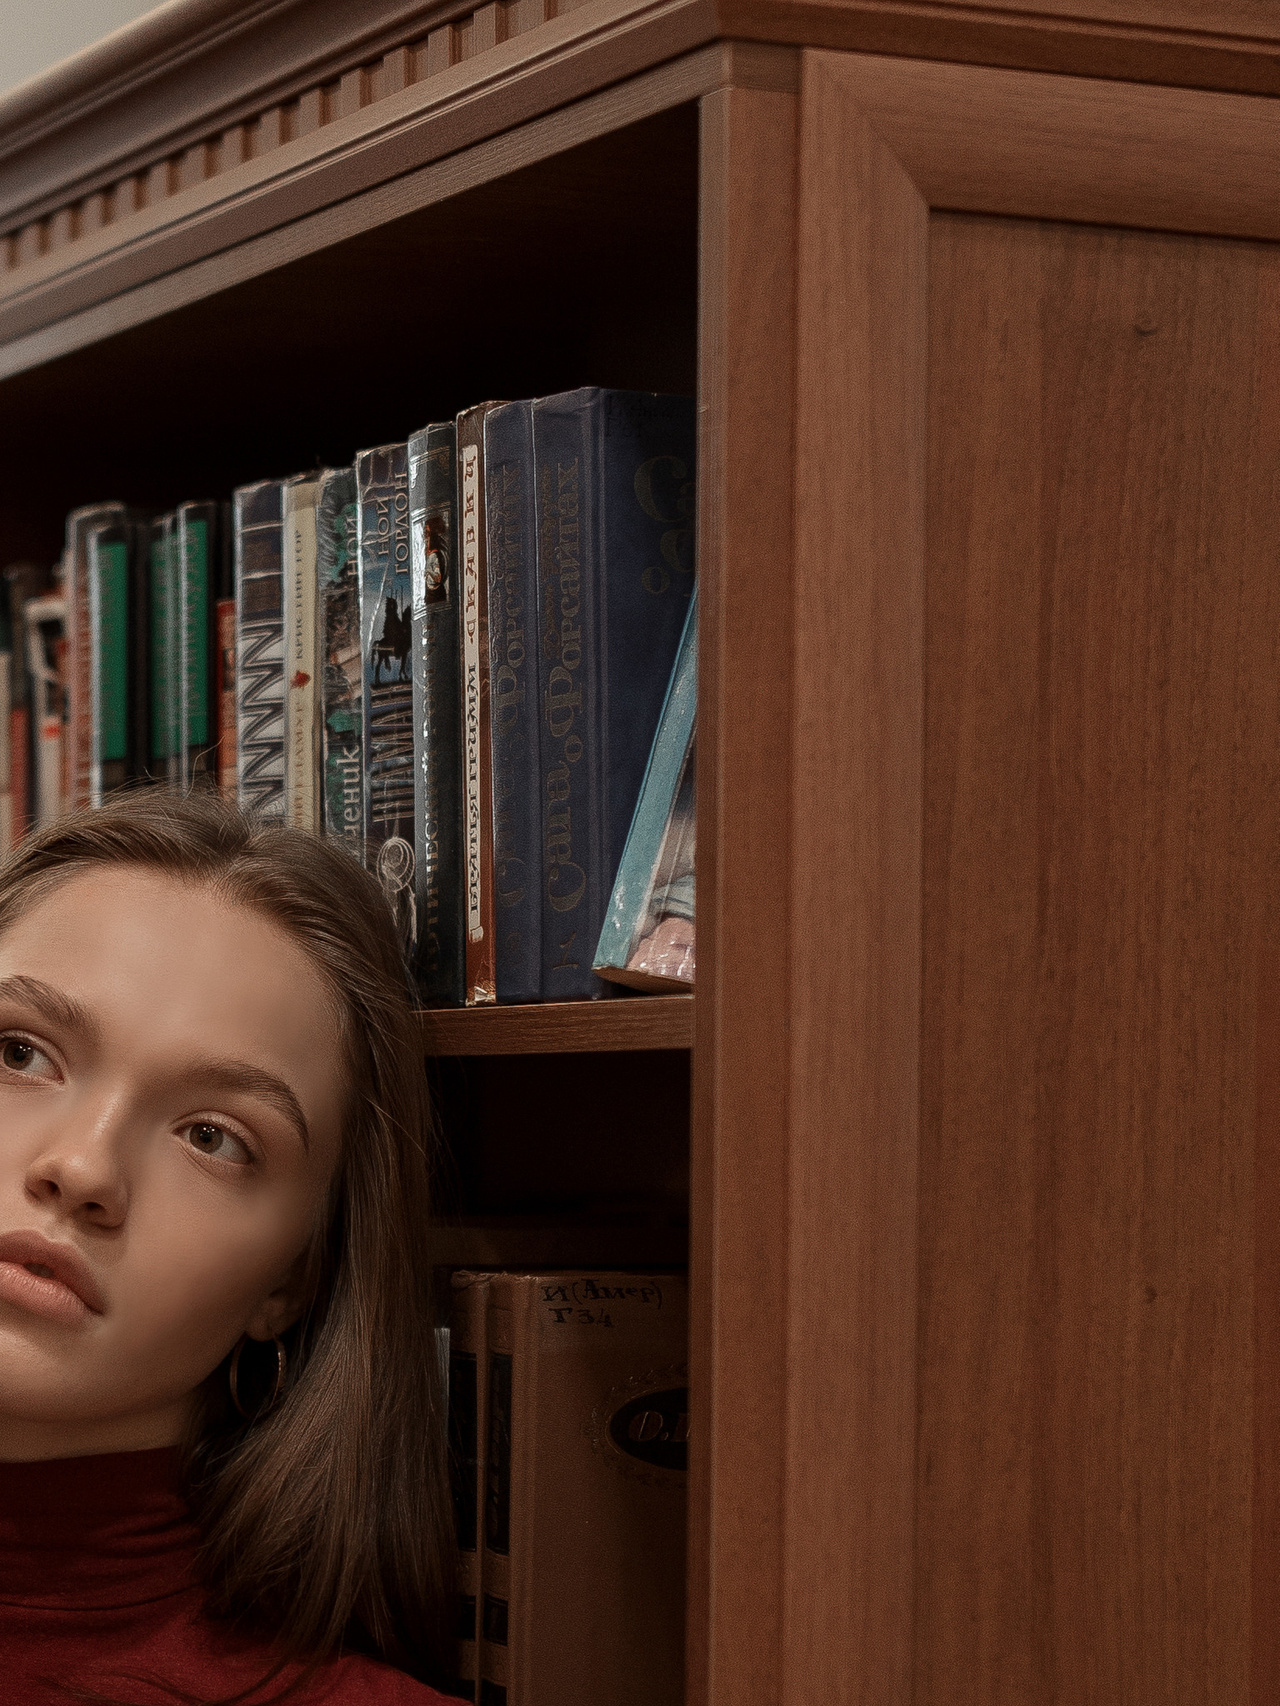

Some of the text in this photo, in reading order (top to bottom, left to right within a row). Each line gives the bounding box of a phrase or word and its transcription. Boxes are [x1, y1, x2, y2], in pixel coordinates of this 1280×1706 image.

[294, 529, 304, 563] ГОР
[343, 514, 359, 577] НОЙ
[374, 495, 390, 556] НОЙ
[393, 471, 410, 575] ГОРДОН
[640, 565, 671, 595] о
[542, 455, 586, 913] Сага о Форсайтах
[335, 745, 361, 848] ченик
[369, 680, 415, 823] ШАМАН
[467, 662, 480, 912] БРАТЬЯ ГРИММ
